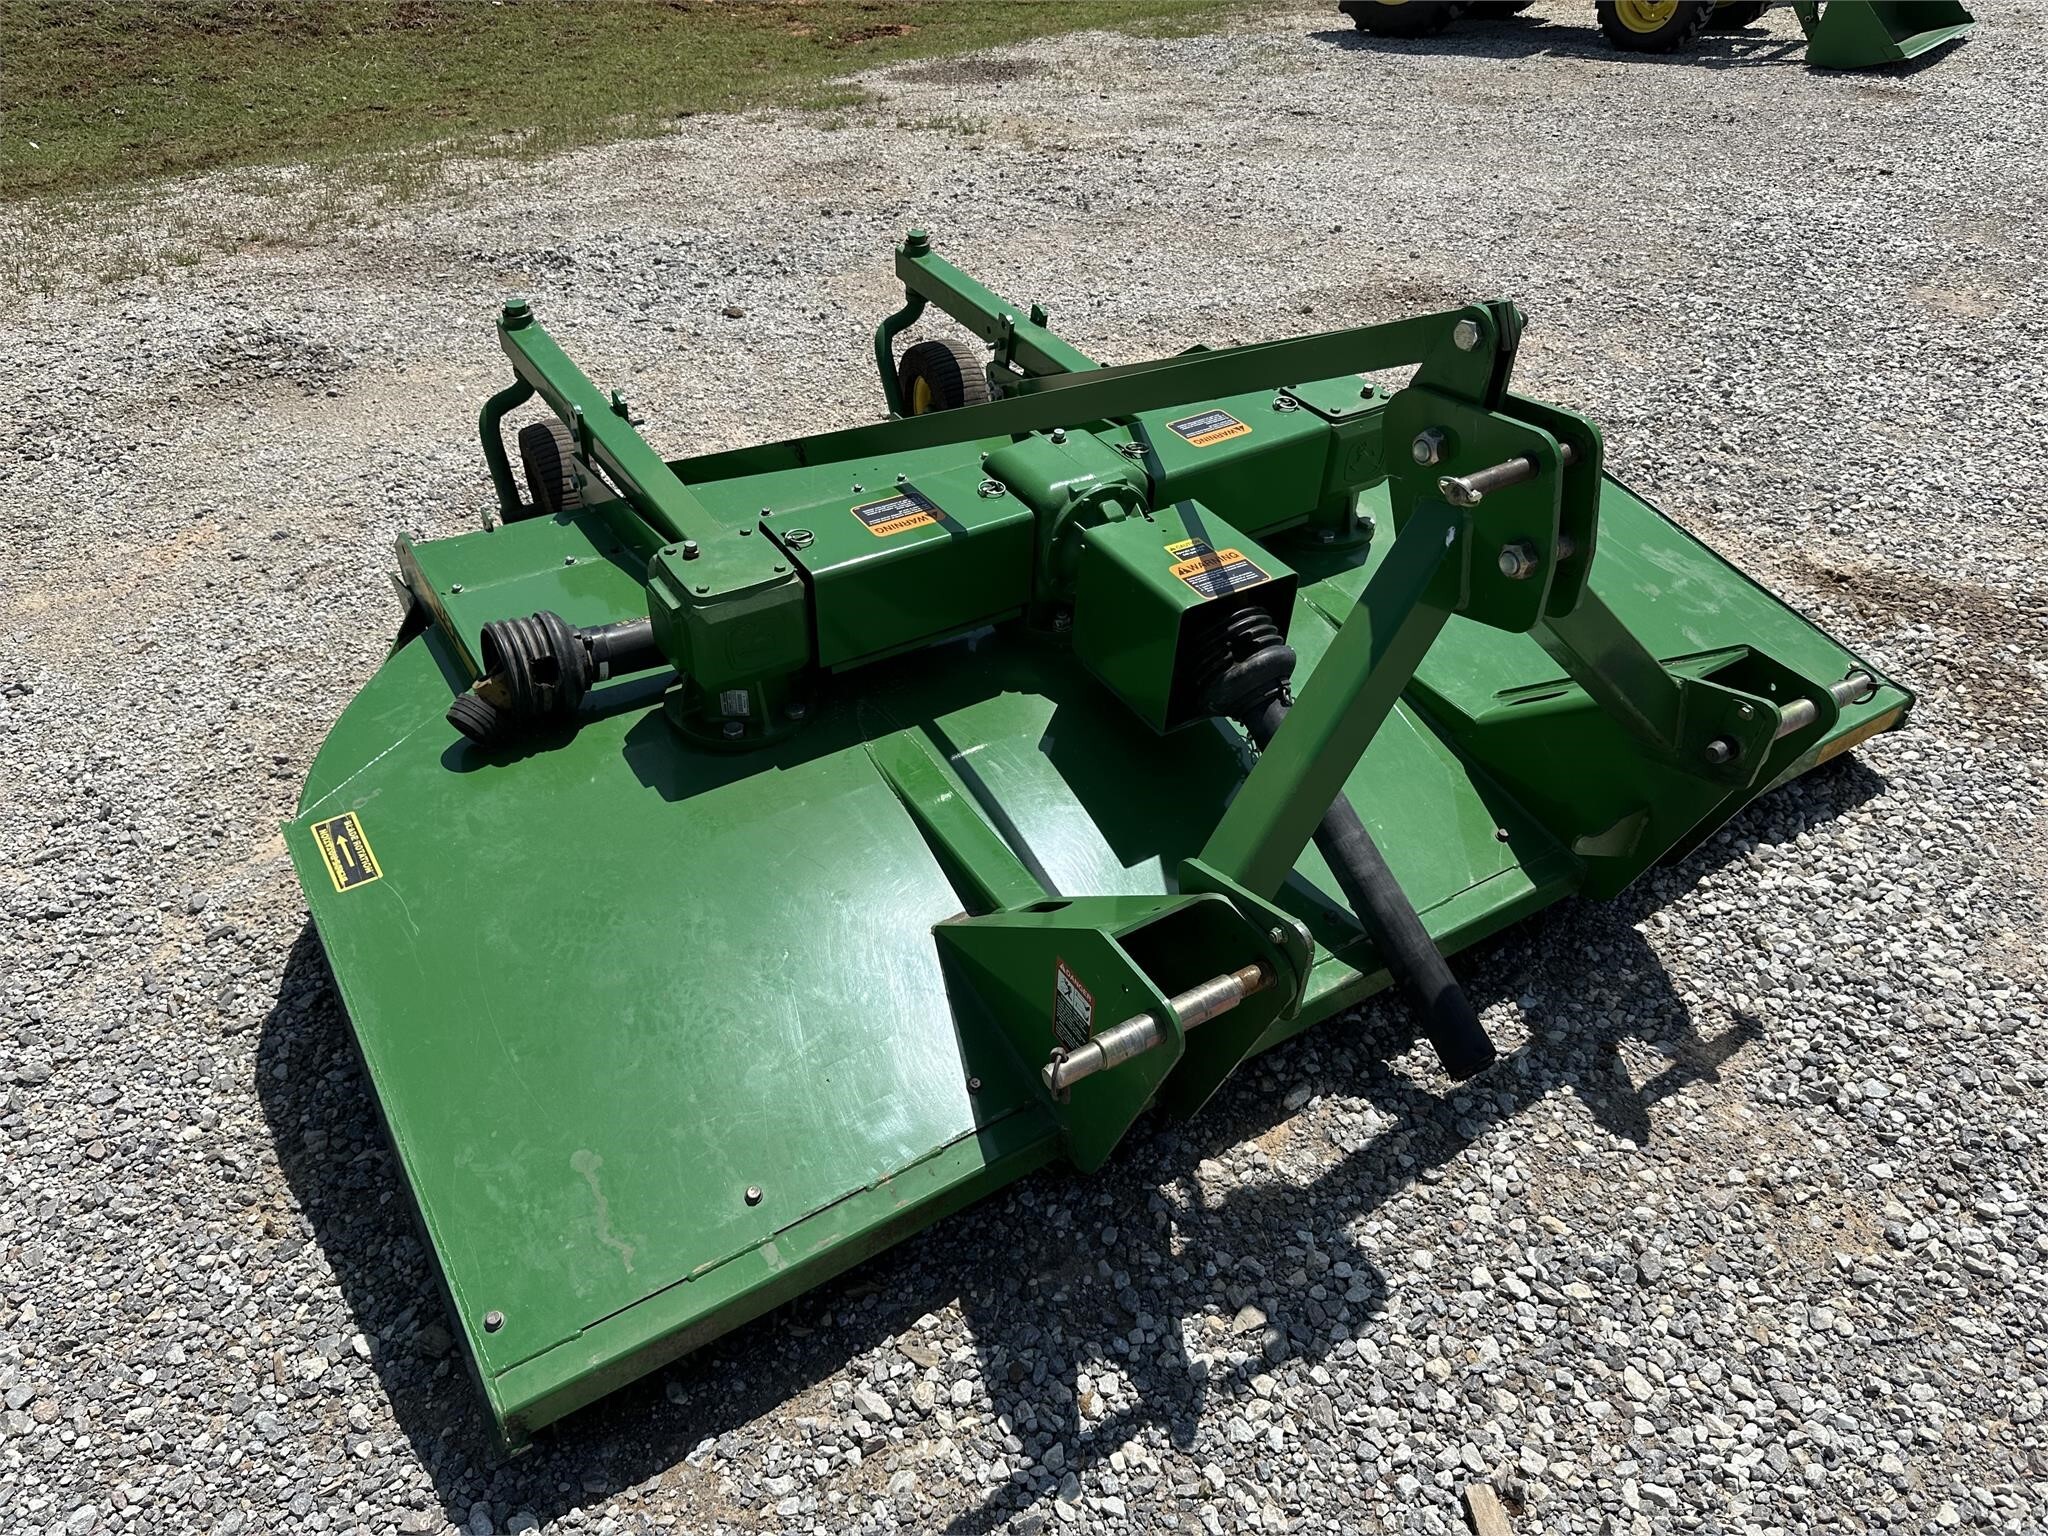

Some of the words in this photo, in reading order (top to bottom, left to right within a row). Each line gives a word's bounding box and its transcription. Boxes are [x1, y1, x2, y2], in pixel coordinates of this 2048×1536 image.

[1193, 428, 1237, 445] WARNING
[875, 515, 929, 534] WARNING
[1188, 552, 1240, 571] WARNING
[343, 819, 359, 842] BLADE
[353, 839, 374, 874] ROTATION
[1065, 968, 1093, 1003] DANGER
